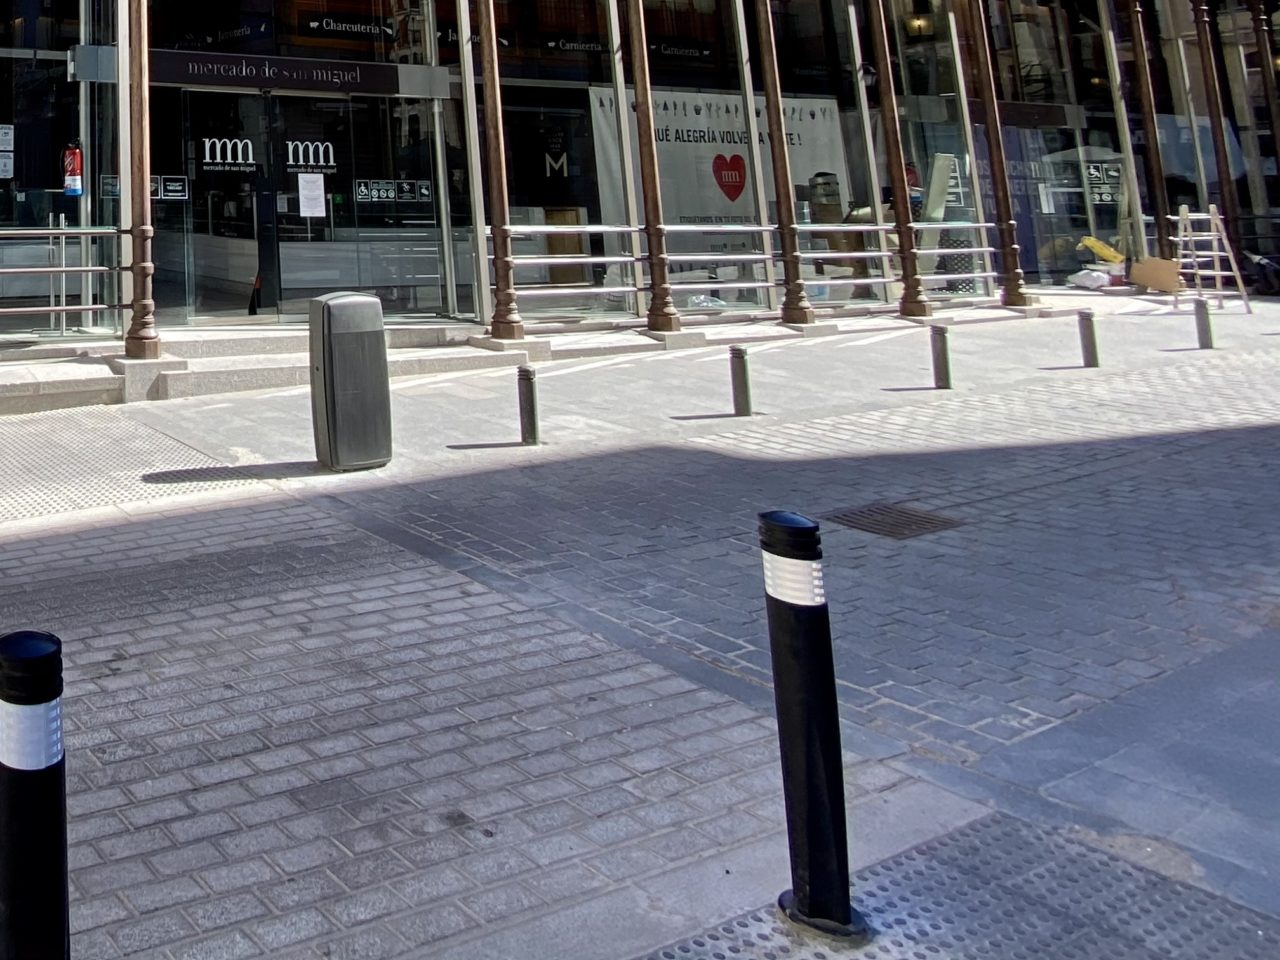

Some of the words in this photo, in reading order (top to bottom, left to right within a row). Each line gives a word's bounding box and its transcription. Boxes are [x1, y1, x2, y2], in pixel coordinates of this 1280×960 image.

[188, 60, 256, 77] mercado
[260, 61, 278, 78] de
[312, 66, 361, 88] miguel
[674, 127, 717, 144] ALEGRÍA
[719, 130, 749, 144] VOLVE
[545, 152, 568, 177] M
